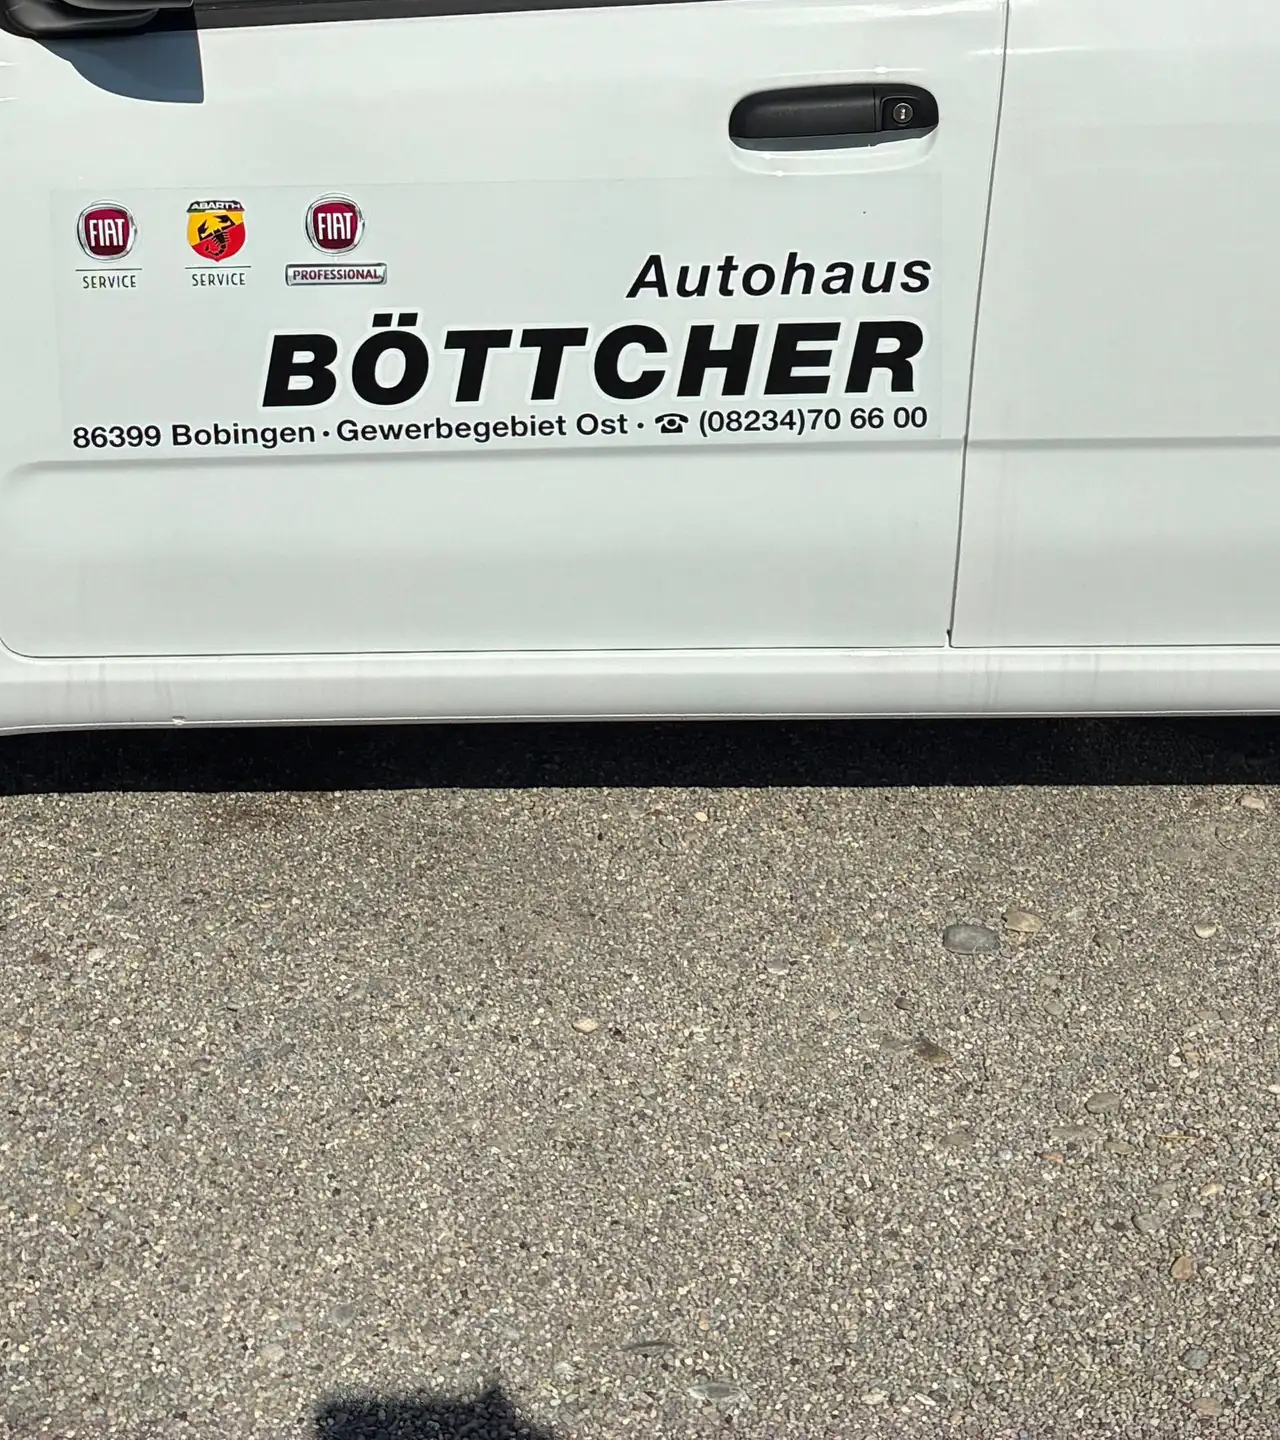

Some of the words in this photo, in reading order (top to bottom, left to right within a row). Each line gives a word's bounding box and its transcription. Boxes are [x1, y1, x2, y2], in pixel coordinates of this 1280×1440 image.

[191, 201, 242, 211] ABARTH
[89, 218, 125, 247] FIAT
[318, 212, 354, 241] FIAT
[82, 274, 137, 289] SERVICE
[192, 272, 246, 287] SERVICE
[292, 268, 380, 282] PROFESSIONAL
[626, 252, 931, 299] Autohaus
[261, 312, 925, 408] BÖTTCHER
[73, 425, 162, 449] 86399
[172, 422, 315, 449] Bobingen
[337, 412, 567, 444] Gewerbegebiet
[576, 413, 628, 436] Ost
[700, 406, 841, 437] (08234)70
[851, 407, 884, 430] 66
[894, 406, 928, 429] 00
